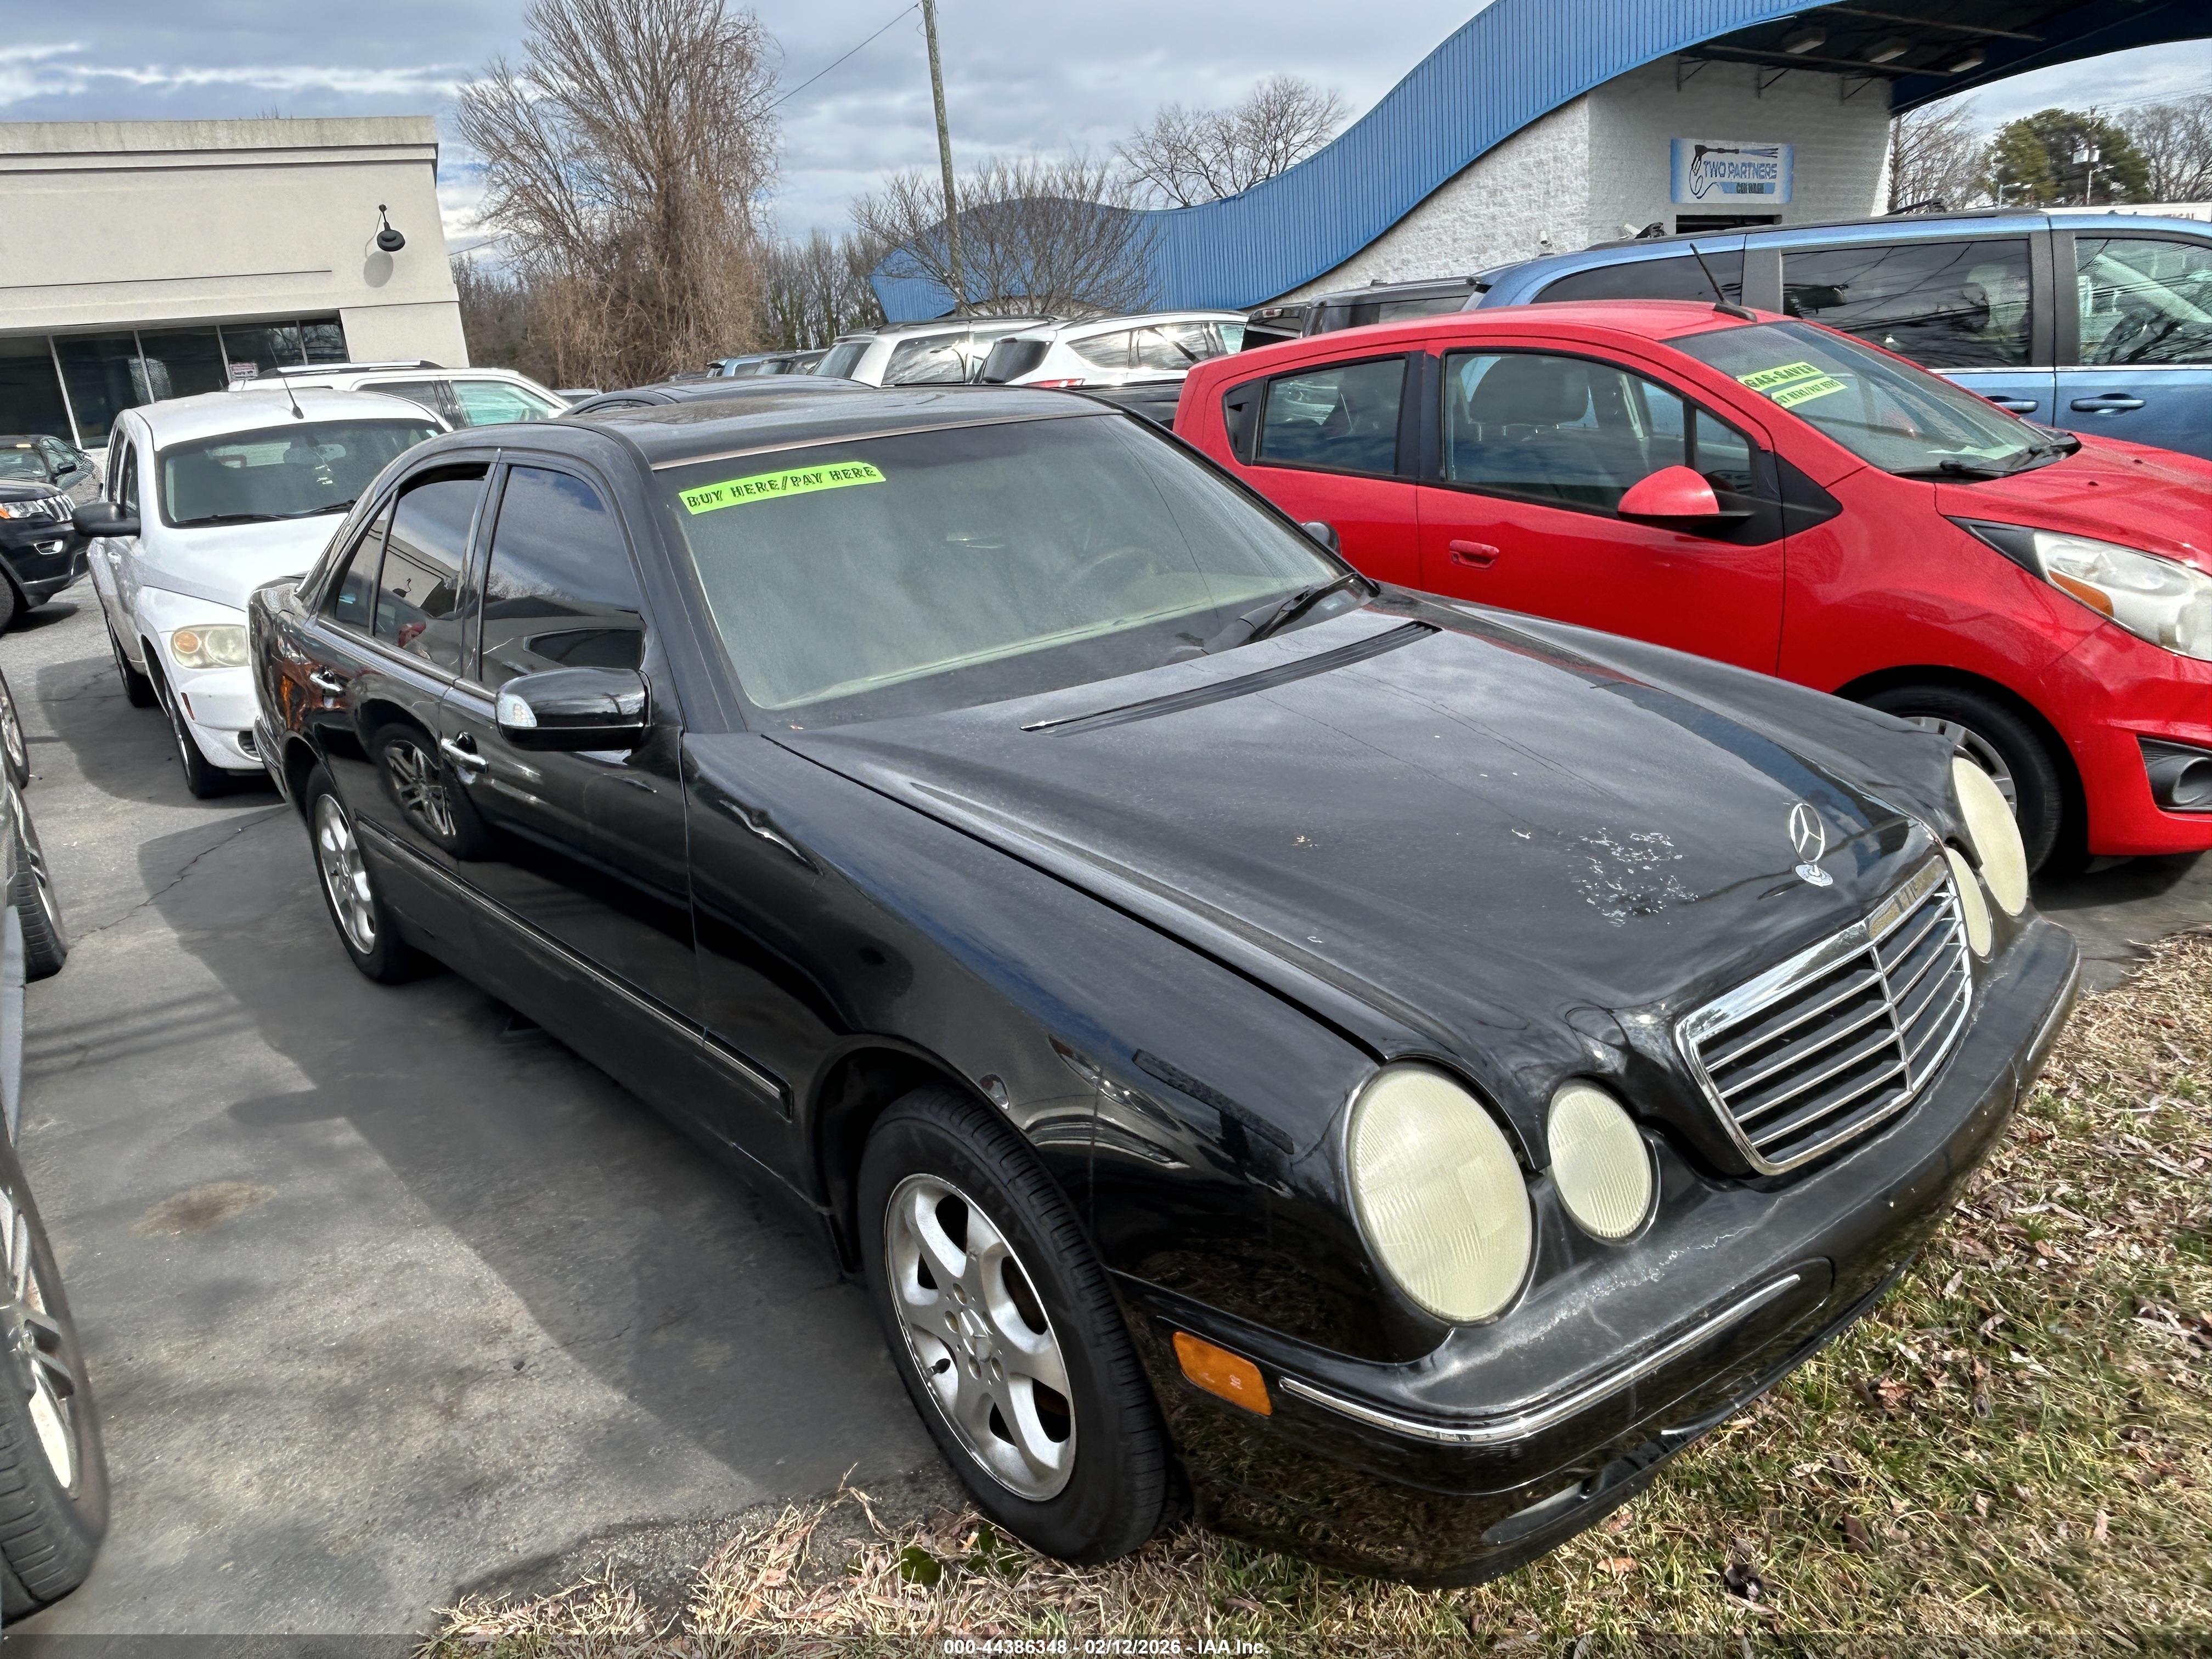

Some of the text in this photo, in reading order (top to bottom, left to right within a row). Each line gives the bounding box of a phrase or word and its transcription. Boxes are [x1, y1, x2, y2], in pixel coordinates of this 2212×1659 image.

[1703, 160, 1778, 179] TWO PARTNERS
[687, 466, 877, 507] BUY HERE/PAY HERE
